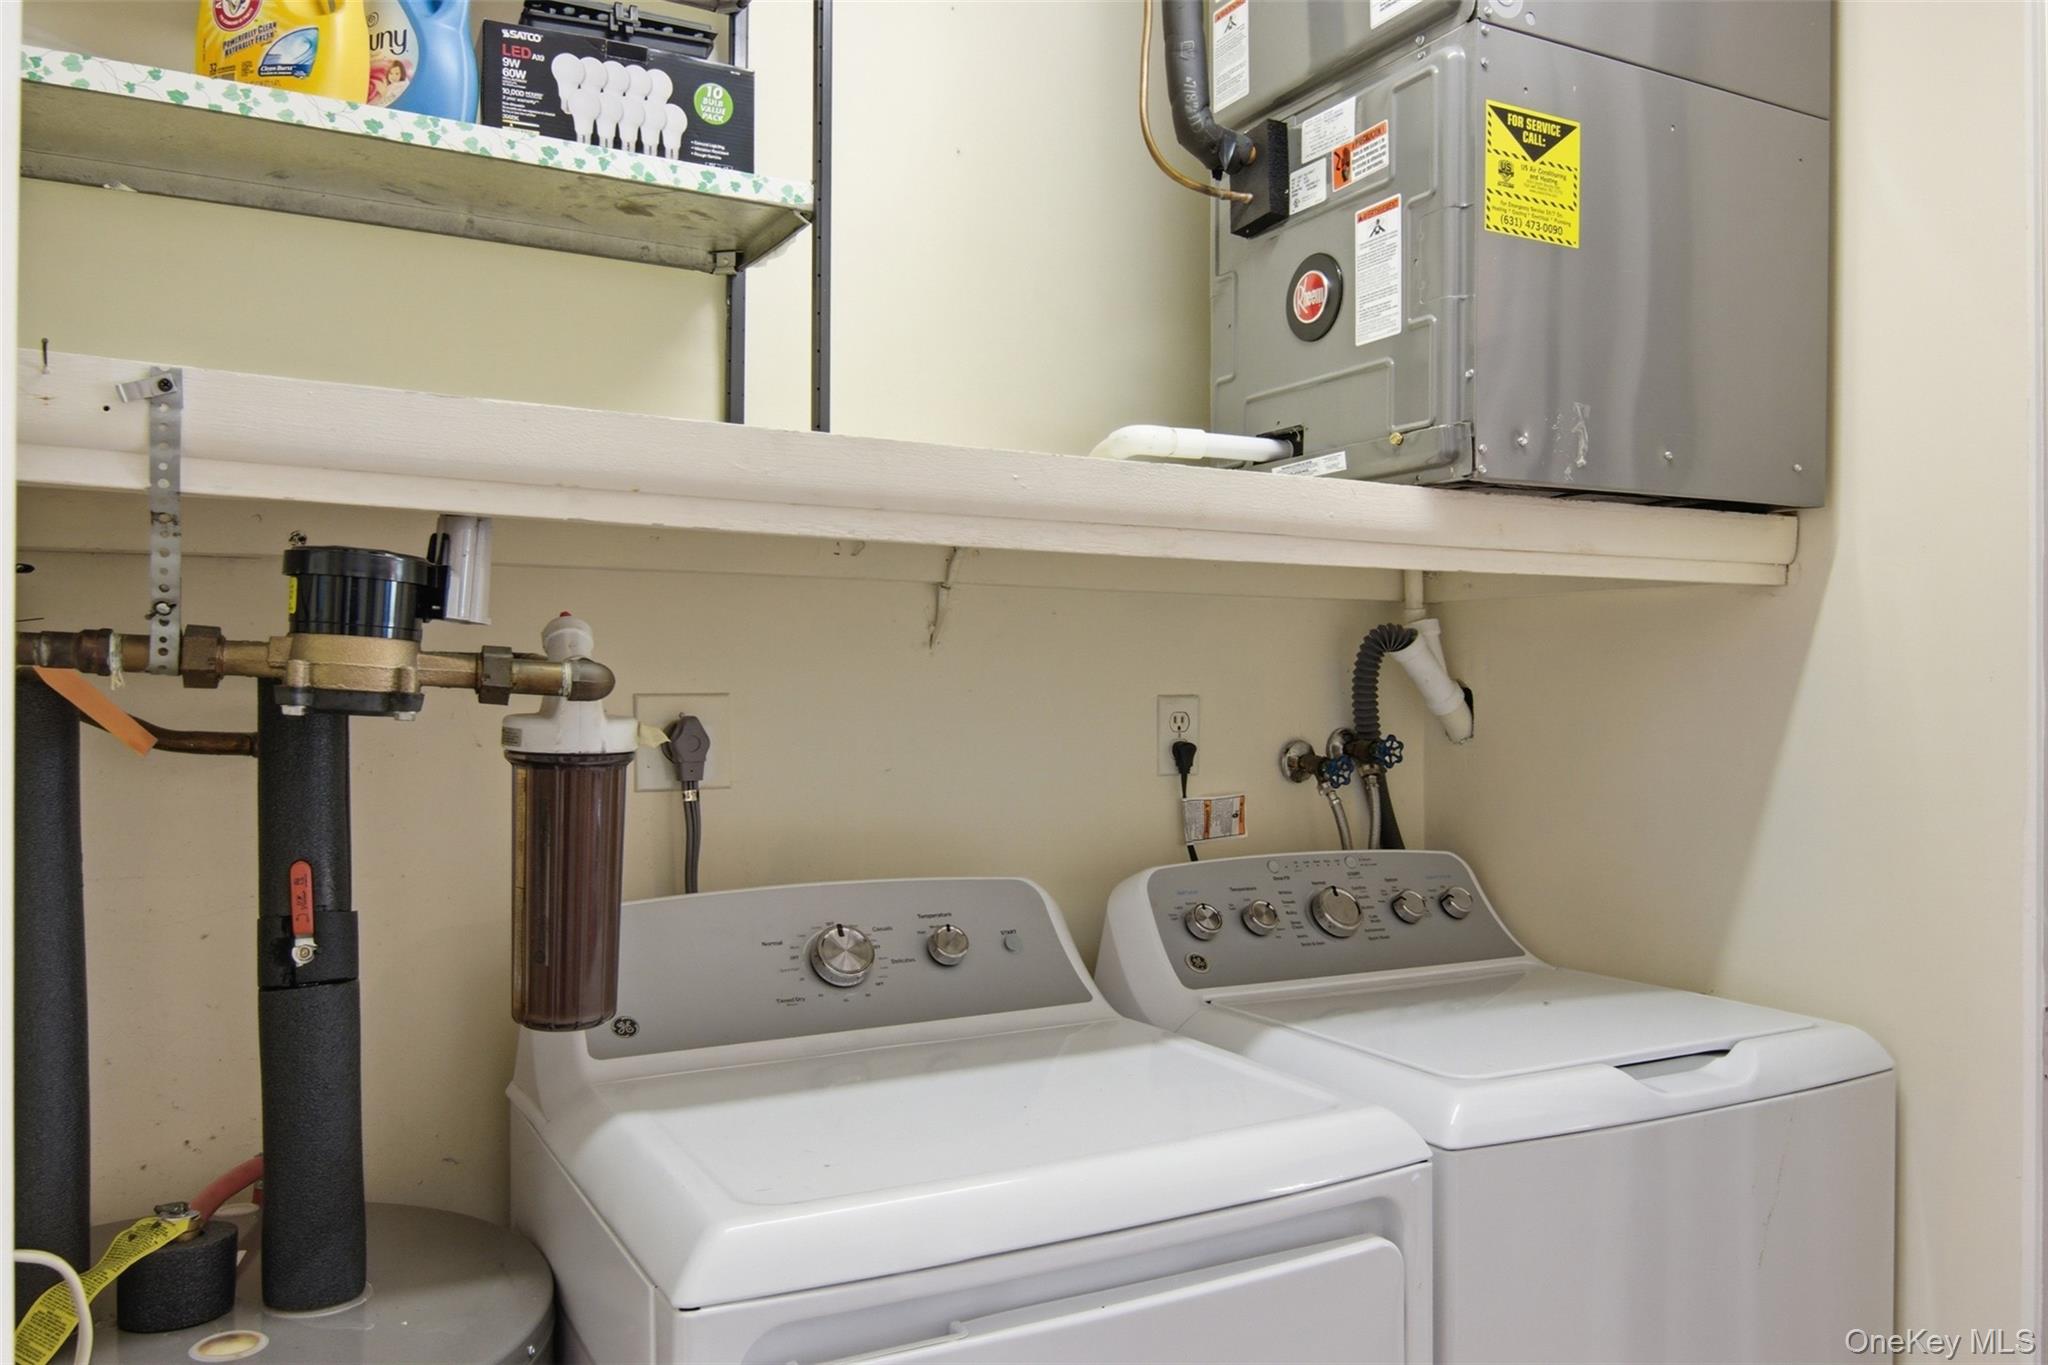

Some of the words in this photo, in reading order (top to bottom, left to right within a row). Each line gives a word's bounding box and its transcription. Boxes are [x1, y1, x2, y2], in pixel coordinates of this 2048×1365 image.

[509, 30, 543, 43] SATCO
[502, 43, 532, 60] LED
[502, 57, 521, 69] 9W
[502, 67, 527, 80] 60W
[706, 85, 723, 100] 10
[702, 96, 723, 107] BULB
[700, 104, 726, 115] VALUE
[702, 112, 724, 123] PACK
[1508, 113, 1524, 128] FOR
[1526, 118, 1561, 137] SERVICE
[1522, 130, 1546, 147] CALL:
[1500, 214, 1522, 228] (631)
[1525, 220, 1563, 235] 473-0090
